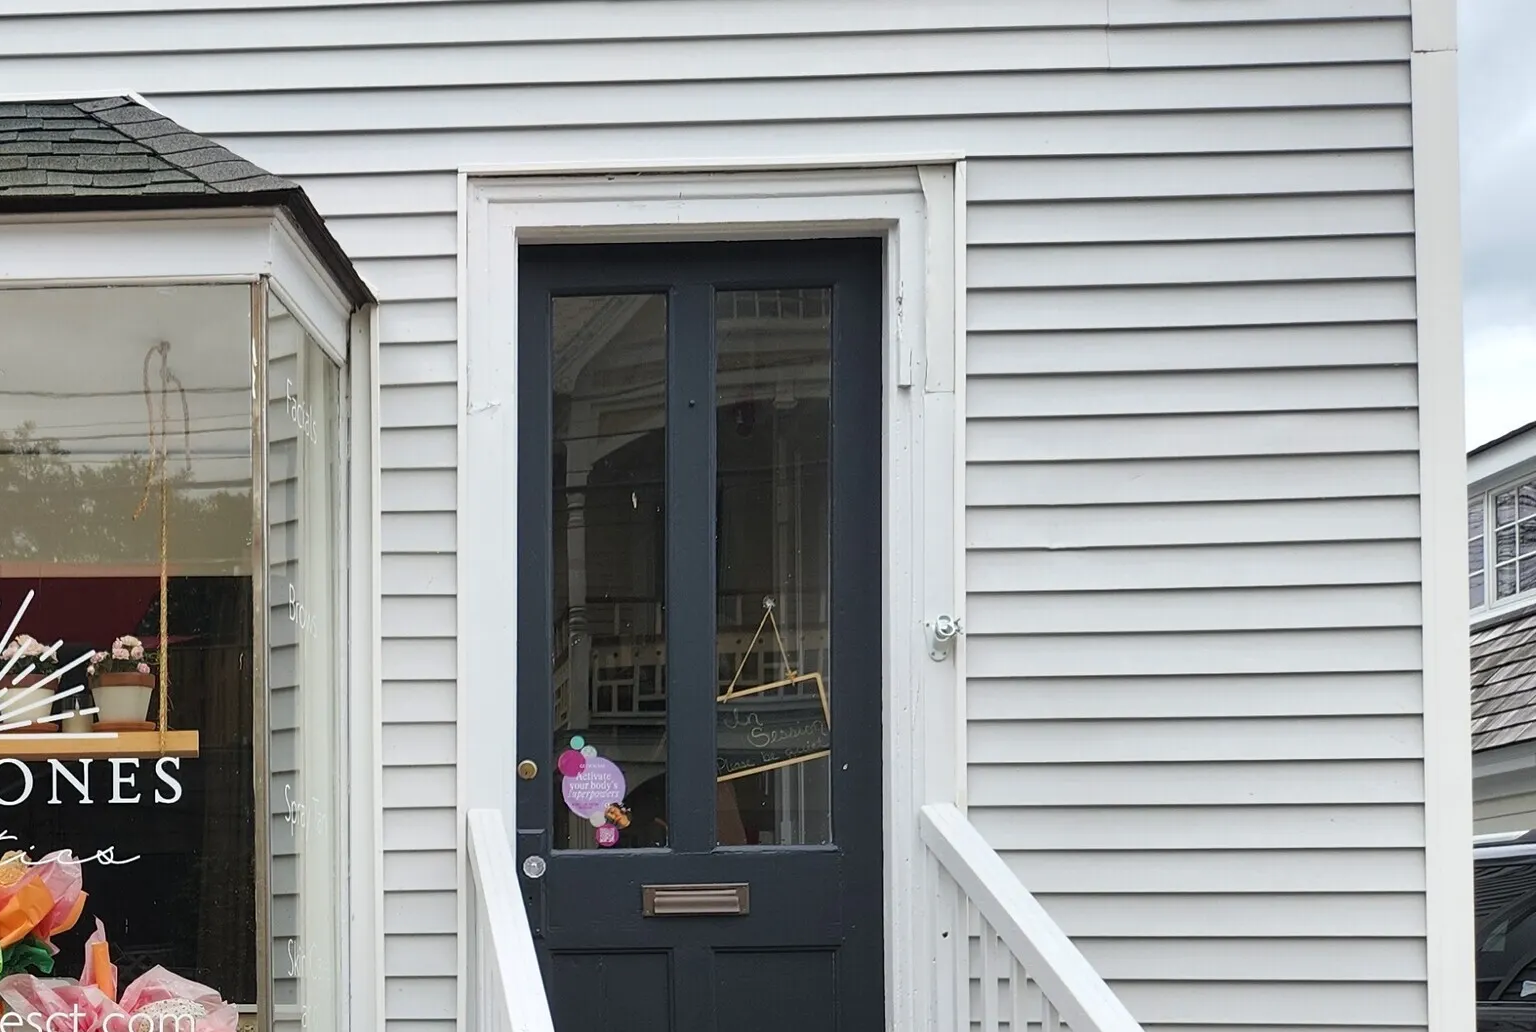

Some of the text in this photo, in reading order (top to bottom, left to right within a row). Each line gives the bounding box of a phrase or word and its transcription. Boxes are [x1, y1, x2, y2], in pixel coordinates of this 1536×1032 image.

[286, 377, 318, 446] Facials
[288, 582, 318, 639] Brows
[723, 707, 763, 729] In
[747, 720, 829, 748] Session
[569, 780, 619, 792] your body's
[576, 771, 611, 781] Activate
[285, 784, 311, 843] Spray
